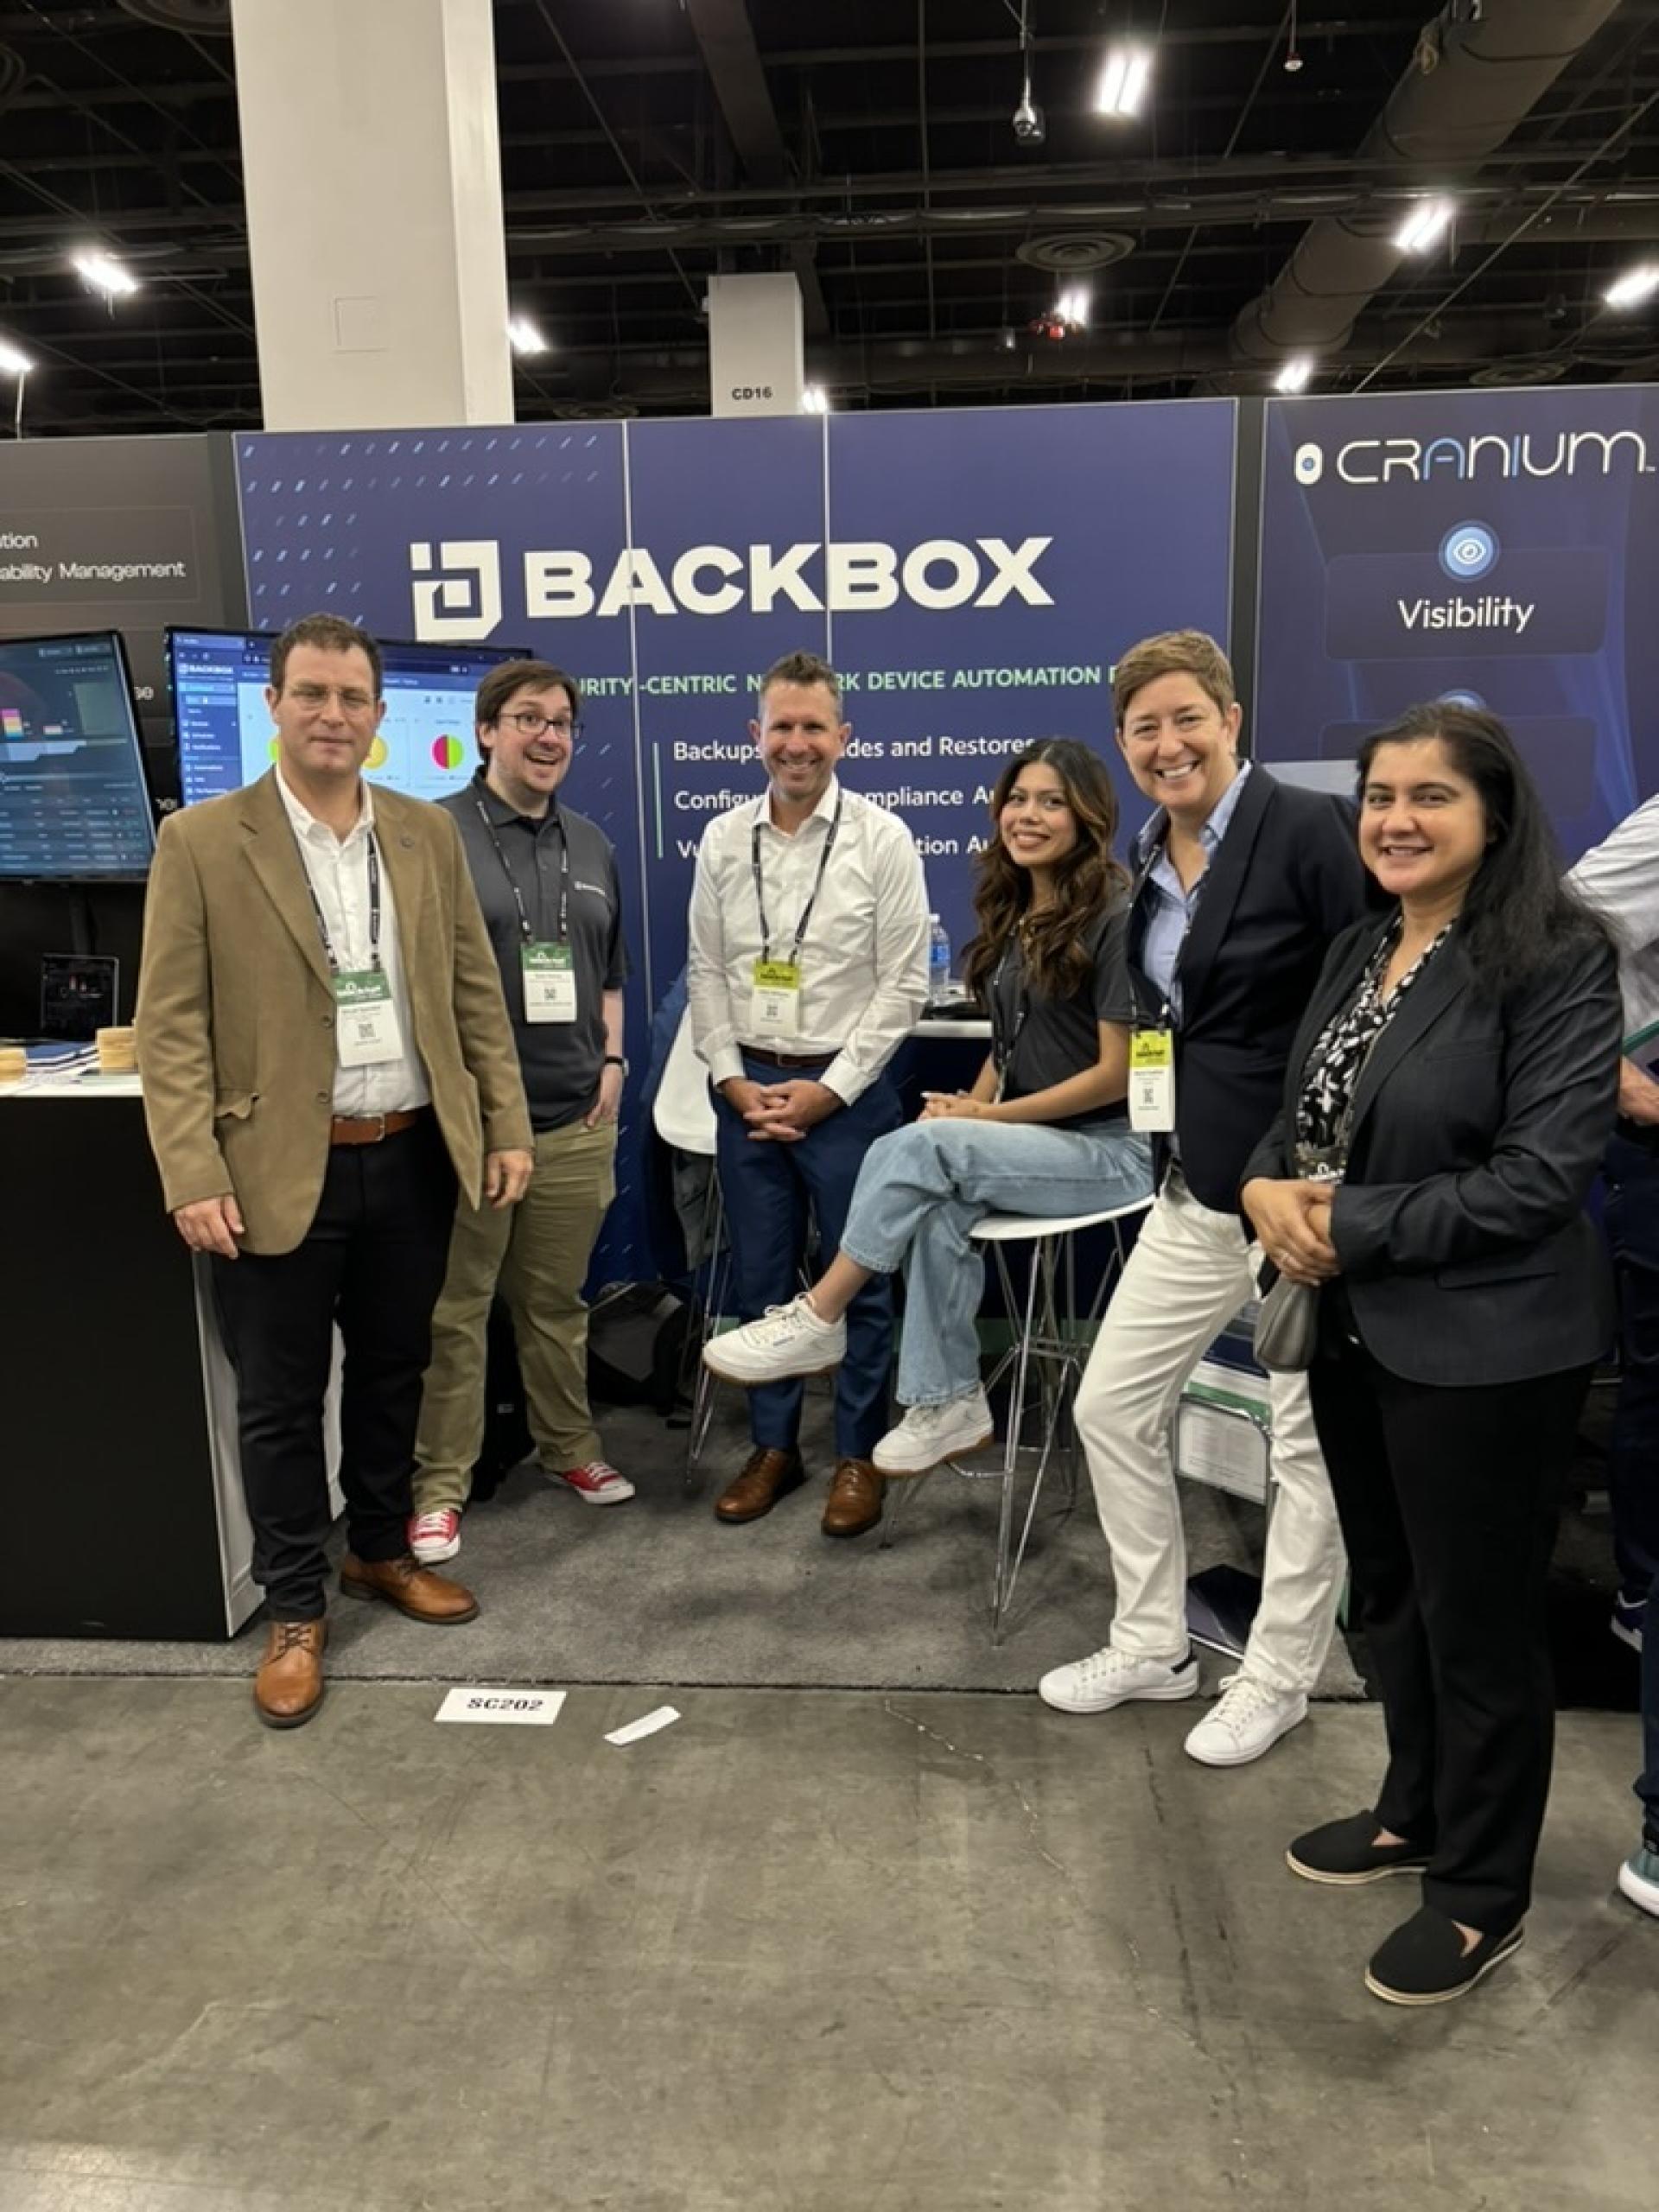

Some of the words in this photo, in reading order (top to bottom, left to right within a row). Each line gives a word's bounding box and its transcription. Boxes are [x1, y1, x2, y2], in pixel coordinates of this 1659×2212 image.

[59, 562, 186, 582] Management
[524, 536, 1056, 619] BACKBOX
[1397, 596, 1535, 633] Visibility
[868, 671, 945, 690] DEVICE
[952, 665, 1100, 689] AUTOMATION
[890, 737, 931, 756] and
